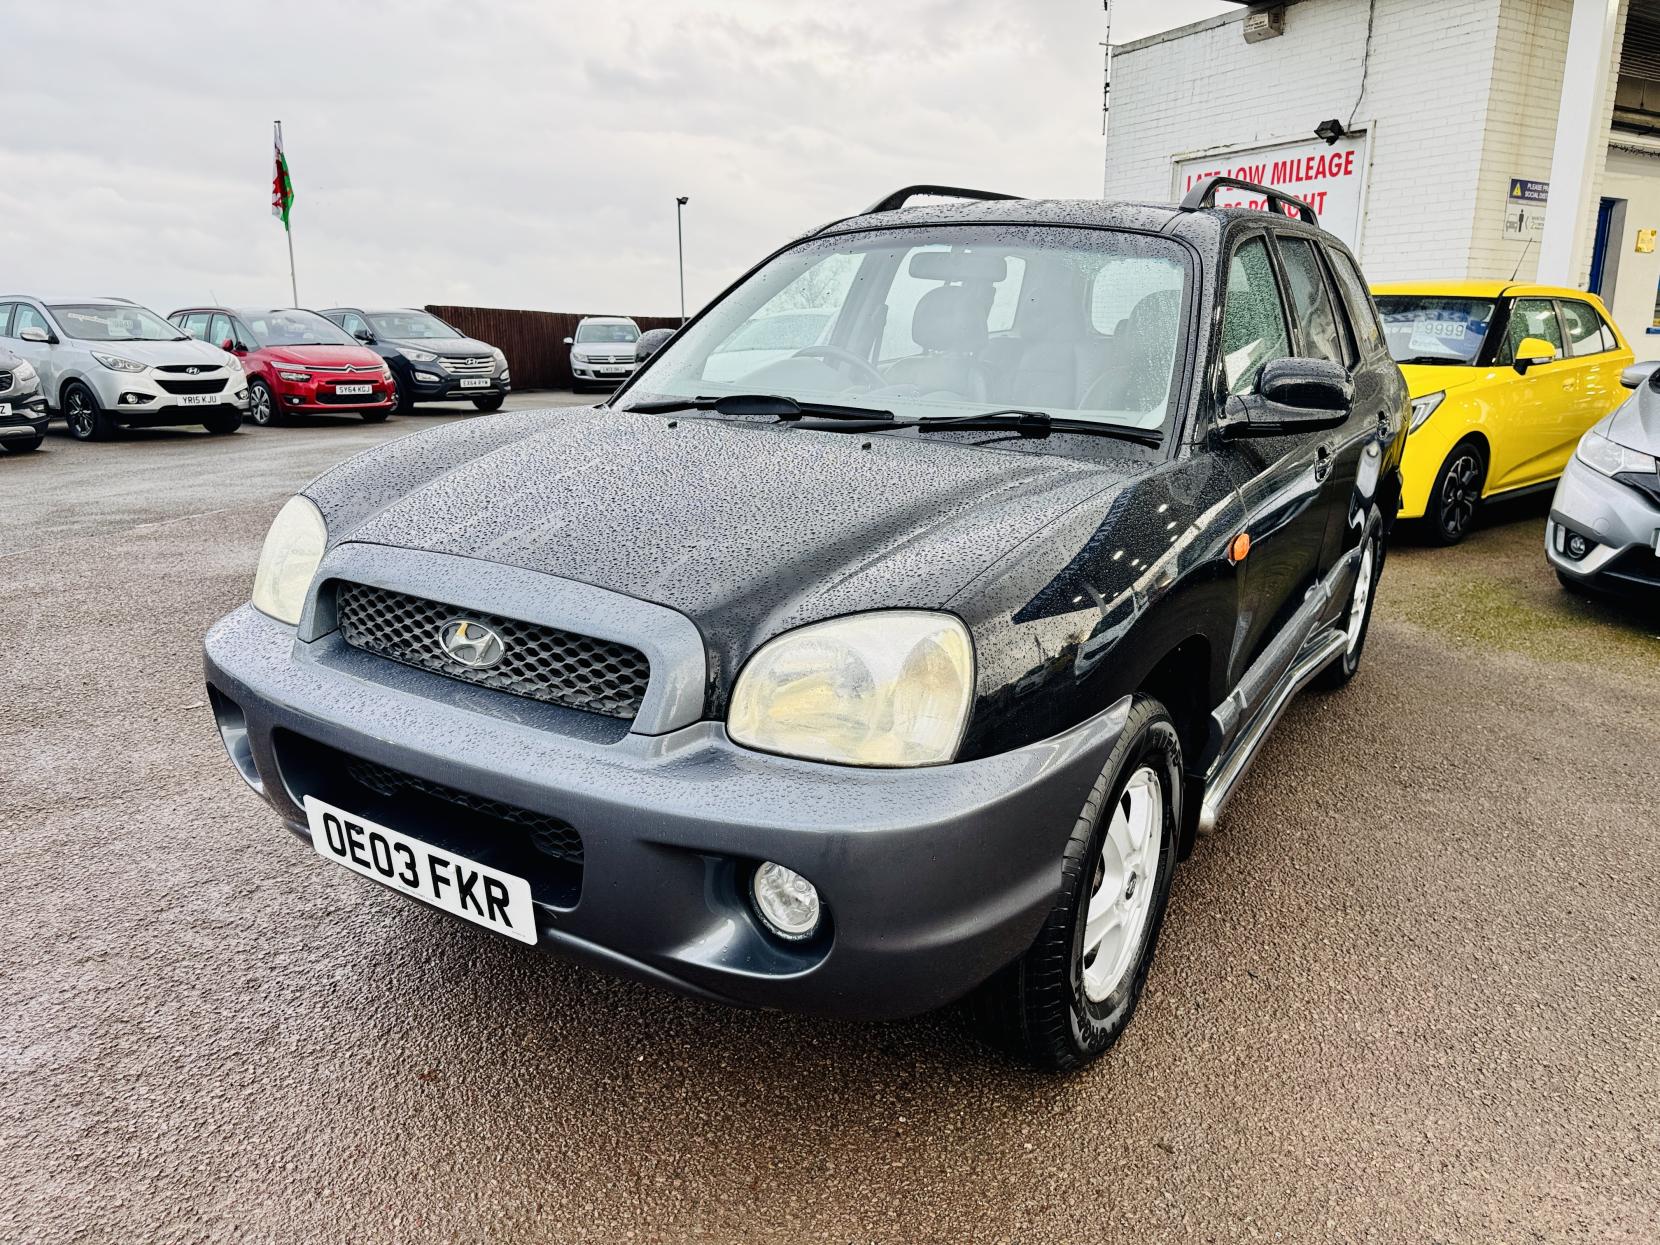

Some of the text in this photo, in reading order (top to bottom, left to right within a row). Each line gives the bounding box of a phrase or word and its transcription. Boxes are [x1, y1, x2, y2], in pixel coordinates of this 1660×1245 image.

[1271, 150, 1355, 186] MILEAGE
[182, 395, 217, 404] YR15 KJU
[322, 812, 514, 928] OE03 FKR
